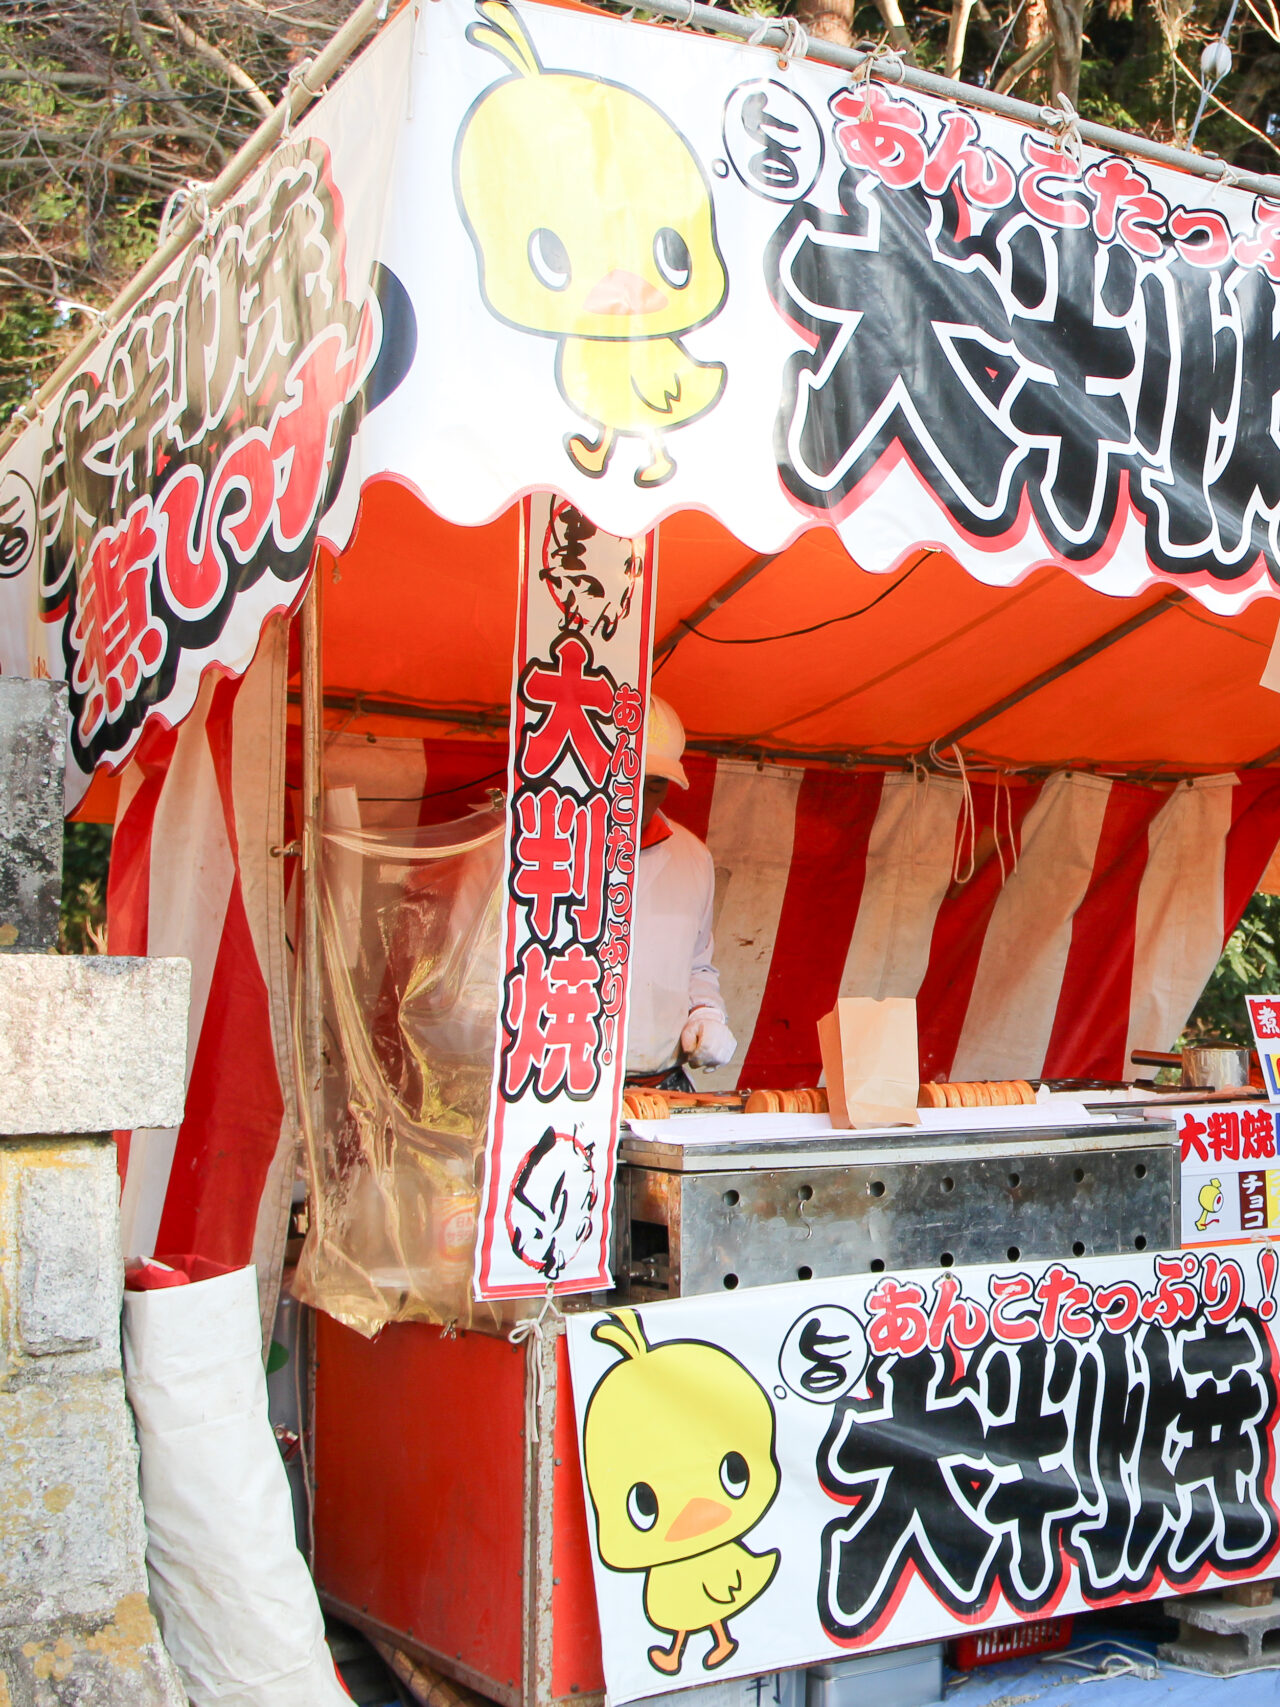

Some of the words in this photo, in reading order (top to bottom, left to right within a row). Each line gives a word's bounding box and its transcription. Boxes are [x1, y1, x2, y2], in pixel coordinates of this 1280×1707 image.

[501, 634, 618, 1101] 大判焼
[601, 683, 643, 1066] あんこたっぷり！
[1179, 1109, 1276, 1163] 大判焼
[1241, 1174, 1265, 1229] チョコ
[866, 1248, 1279, 1357] あんこたっぷり！
